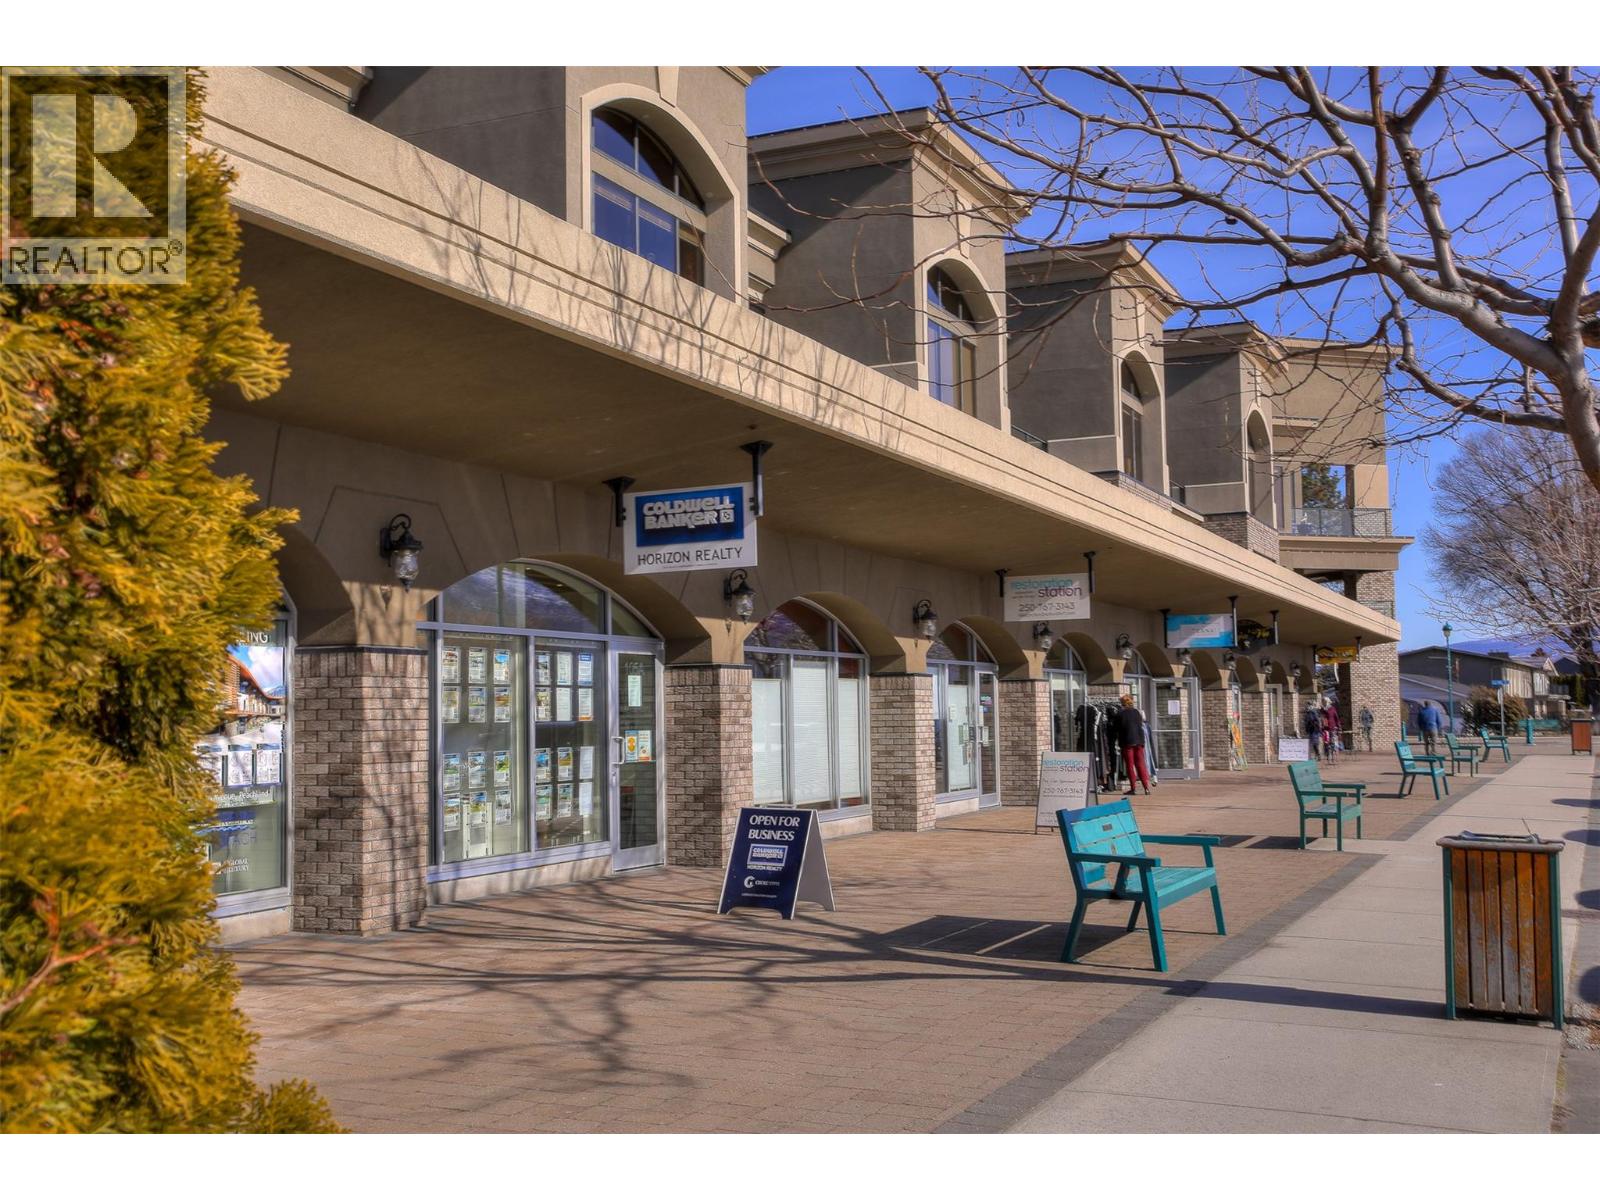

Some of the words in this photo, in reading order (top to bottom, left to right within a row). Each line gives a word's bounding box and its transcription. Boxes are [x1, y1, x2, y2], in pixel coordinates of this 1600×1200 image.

[643, 496, 735, 516] COLDWELL
[644, 510, 718, 530] BANKER
[637, 551, 690, 566] HORIZON
[695, 547, 742, 562] REALTY
[1038, 585, 1082, 598] station
[1060, 765, 1089, 773] station
[749, 814, 777, 826] OPEN
[779, 816, 800, 827] FOR
[748, 829, 795, 841] BUSINESS
